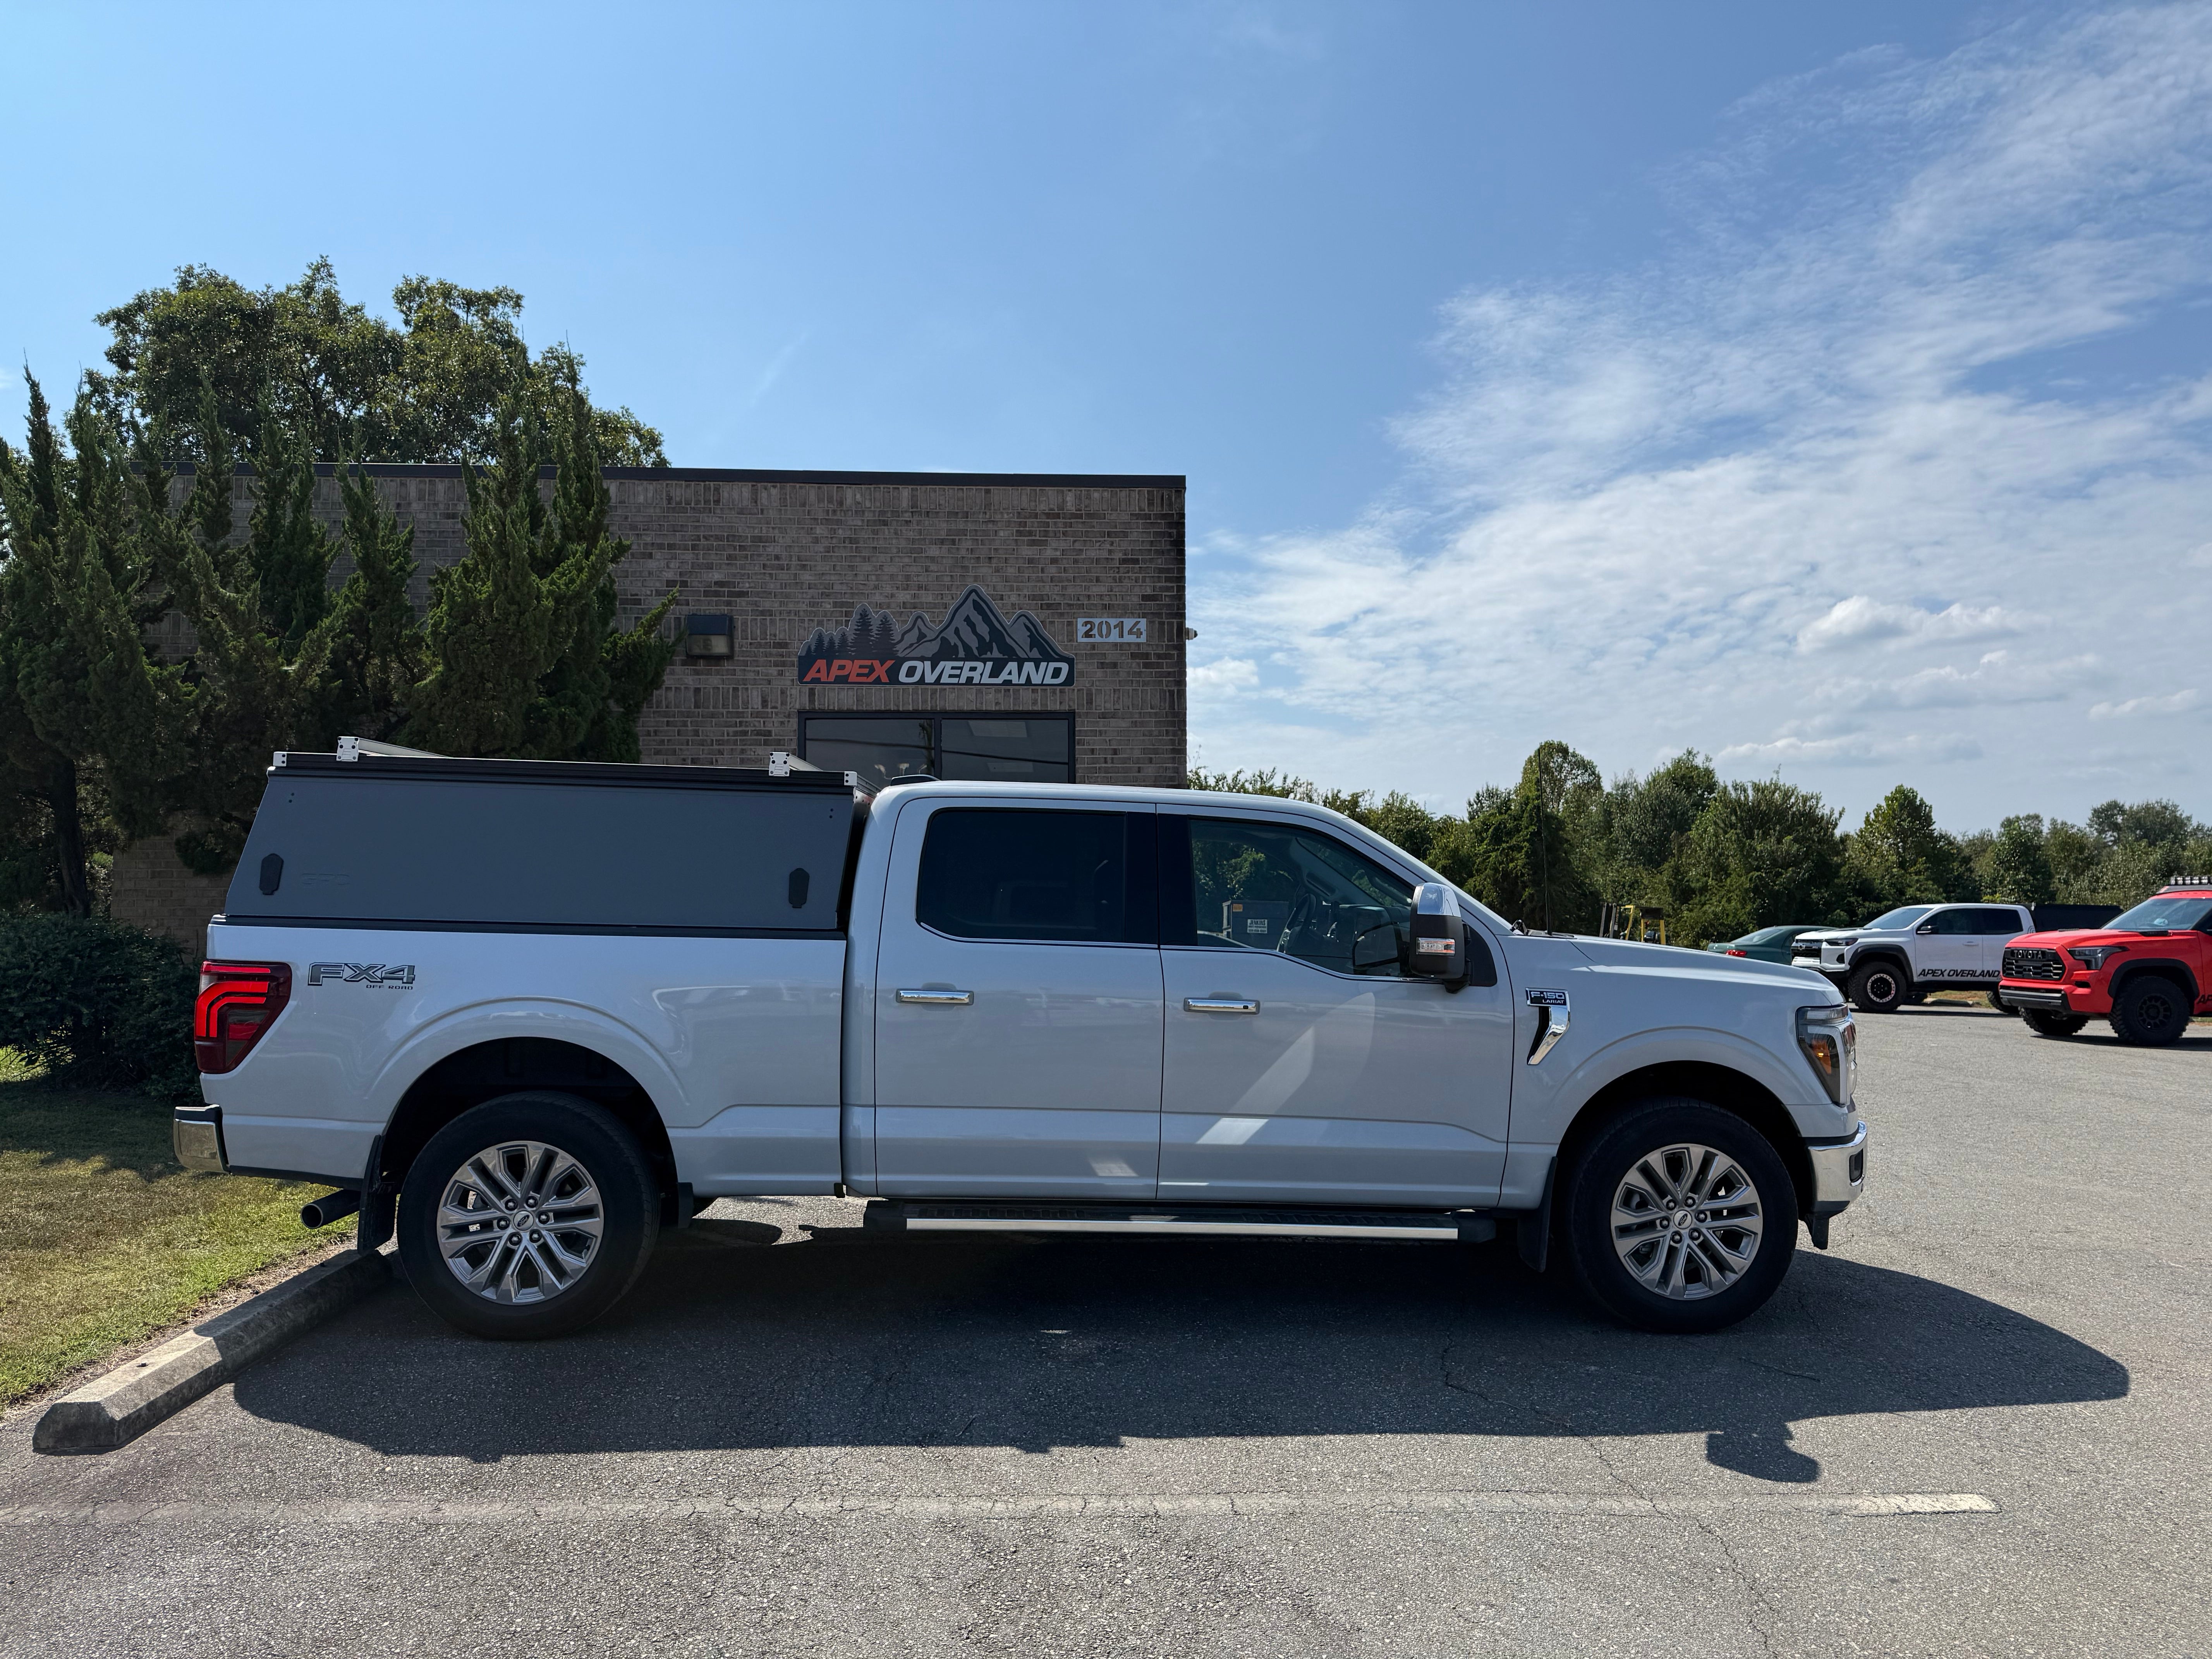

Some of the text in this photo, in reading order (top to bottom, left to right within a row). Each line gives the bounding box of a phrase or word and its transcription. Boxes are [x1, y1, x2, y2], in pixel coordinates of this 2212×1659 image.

[1082, 621, 1143, 638] 2014
[802, 659, 1069, 684] APEX OVERLAND
[2014, 950, 2042, 959] TOYOTA
[308, 962, 415, 986] FX4
[1918, 969, 2001, 977] APEX OVERLAND
